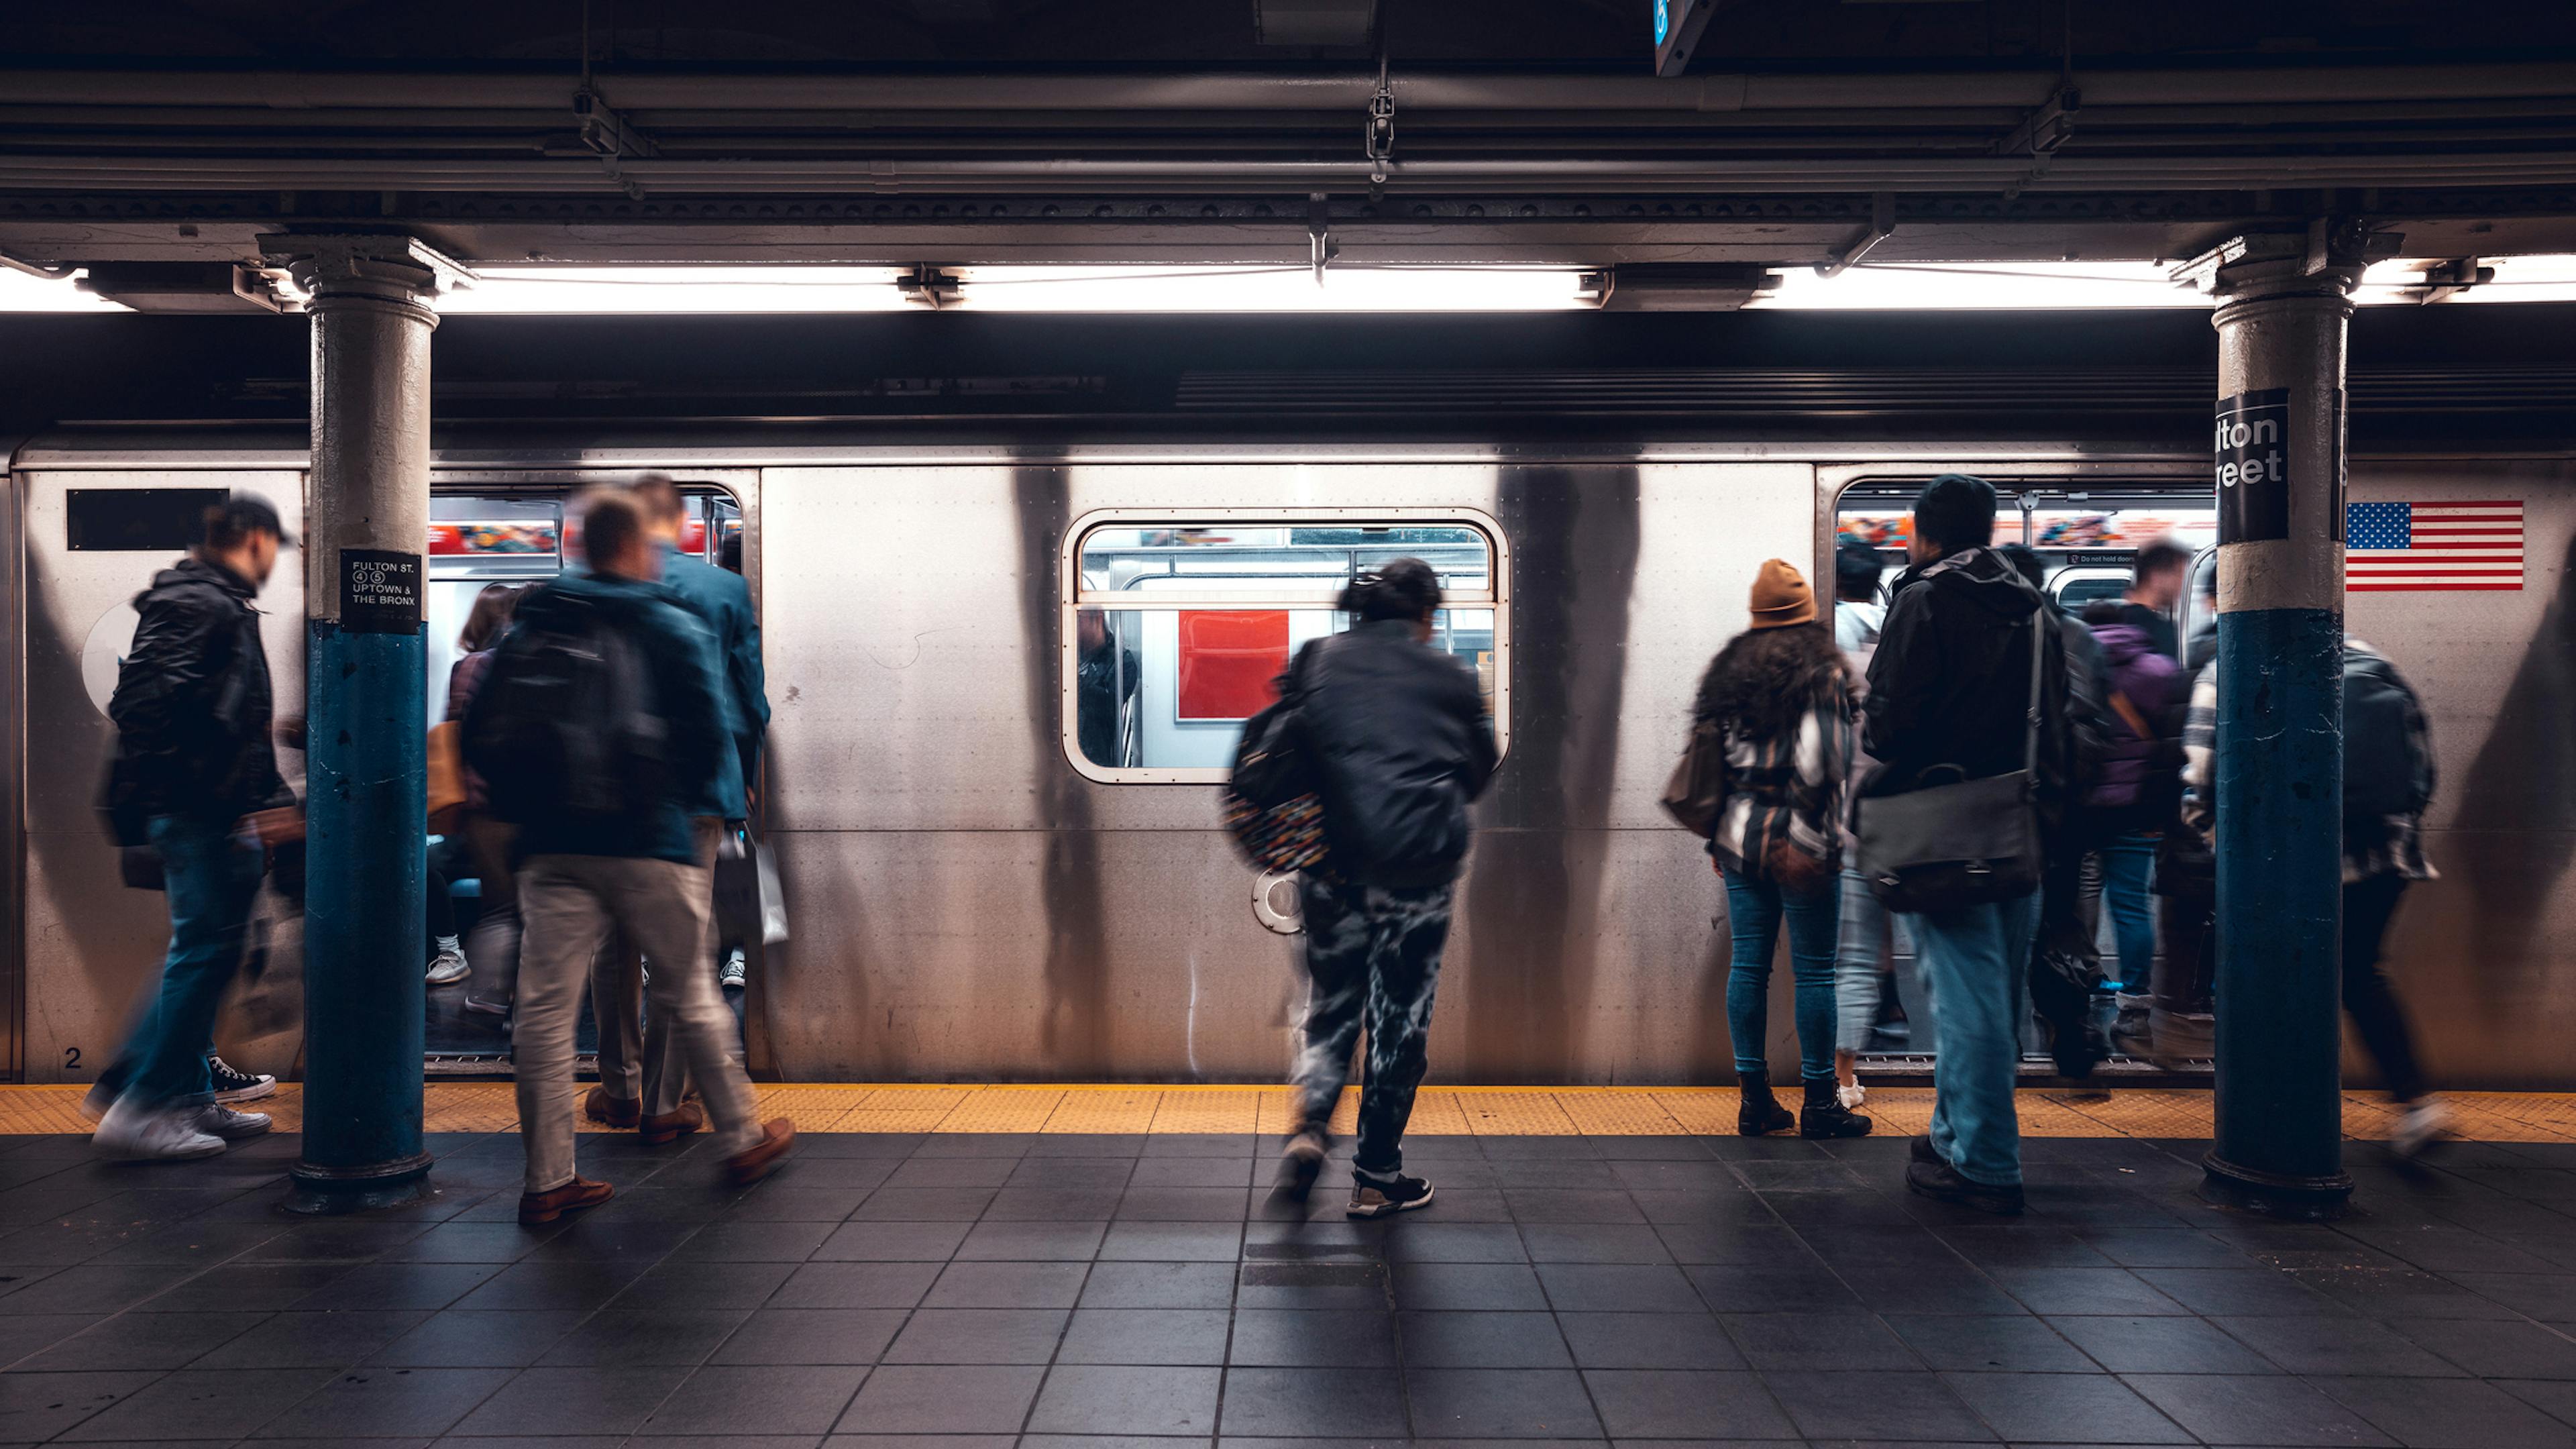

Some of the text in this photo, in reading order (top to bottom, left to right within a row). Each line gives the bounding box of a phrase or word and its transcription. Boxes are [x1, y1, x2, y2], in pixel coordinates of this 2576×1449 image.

[2215, 418, 2278, 454] lton
[353, 561, 414, 573] FULTON ST.
[356, 572, 381, 582] 4 5
[353, 584, 411, 594] UPTOWN &
[353, 595, 415, 606] THE BRONX
[65, 1047, 81, 1069] 2
